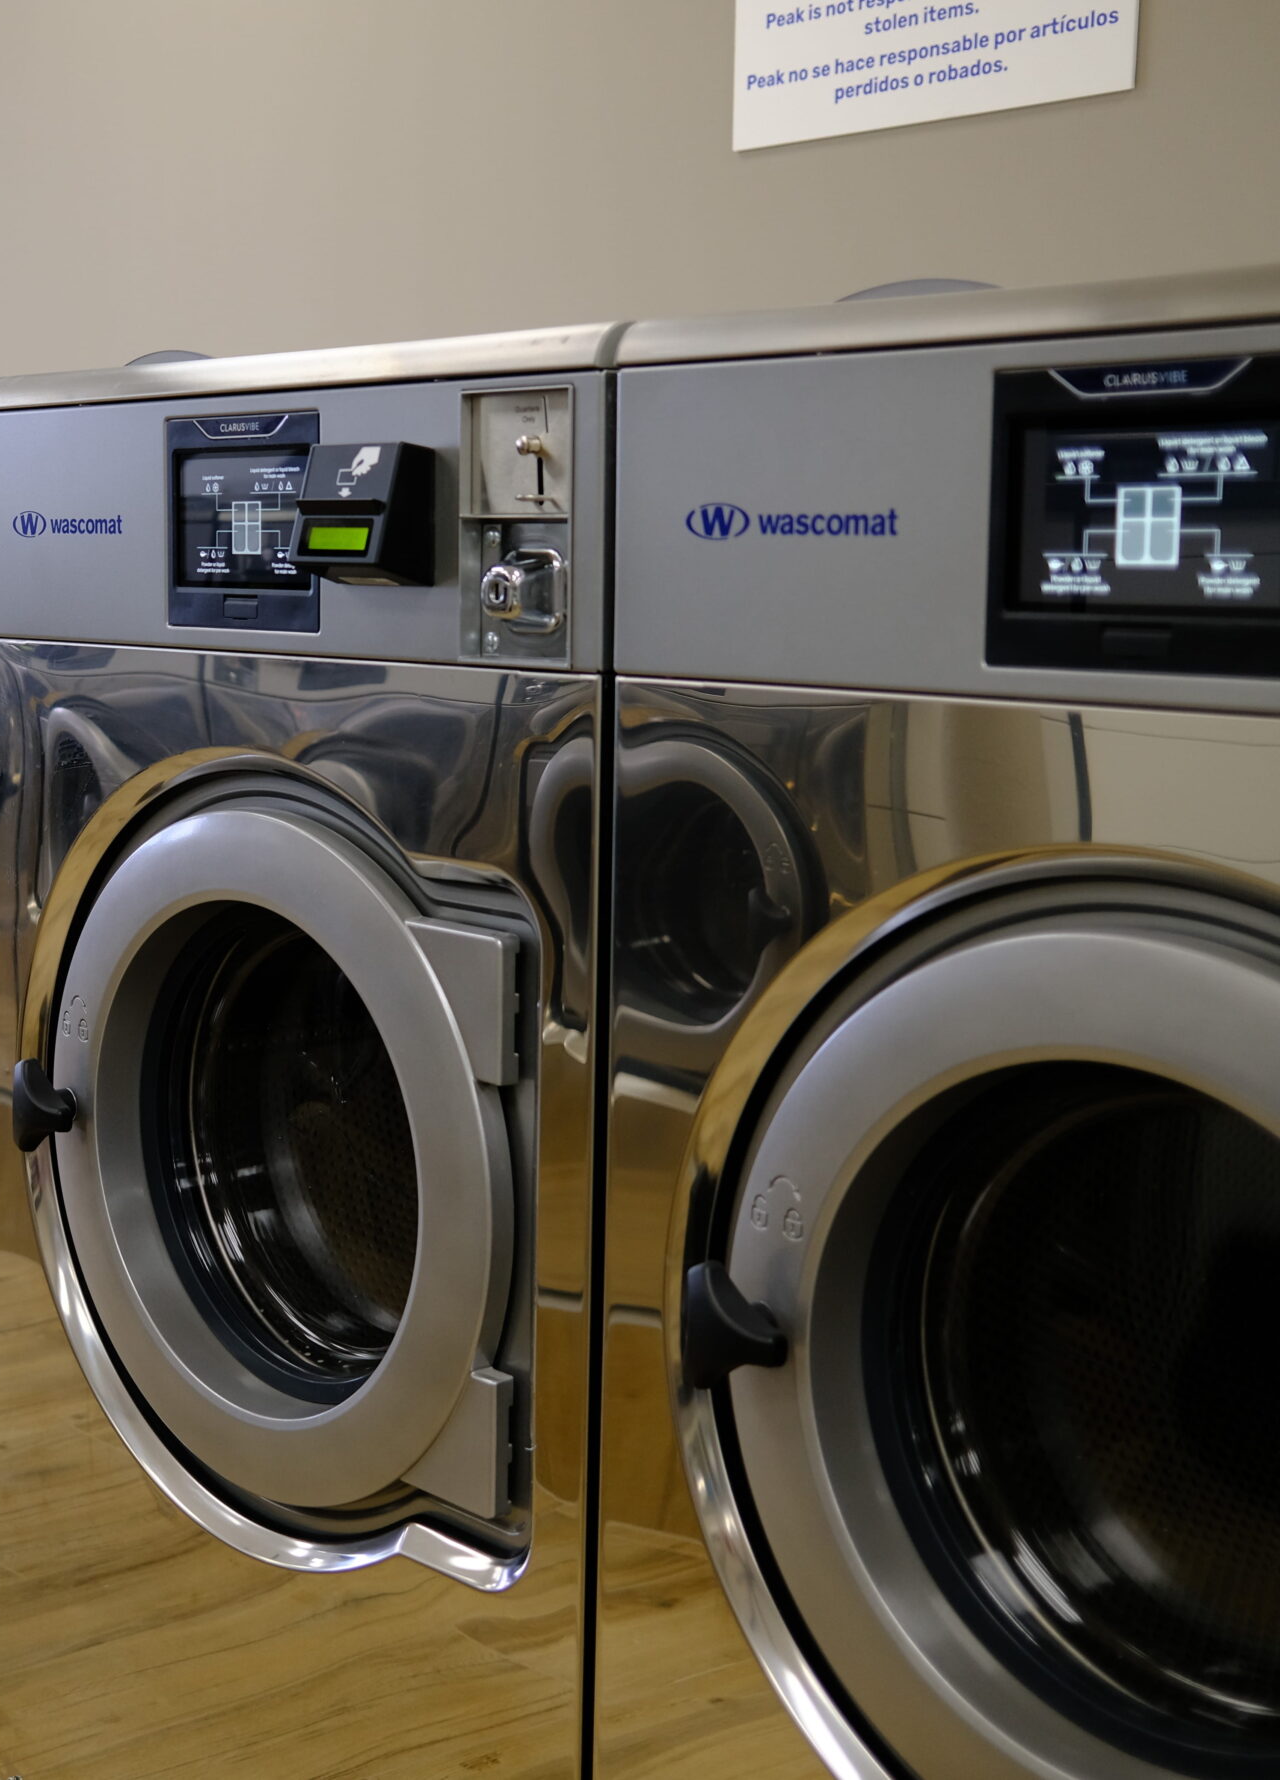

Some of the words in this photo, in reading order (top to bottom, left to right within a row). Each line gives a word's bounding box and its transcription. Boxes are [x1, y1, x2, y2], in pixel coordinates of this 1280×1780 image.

[766, 7, 804, 29] Peak
[808, 4, 821, 21] is
[826, 0, 854, 17] not
[864, 13, 919, 35] stolen
[923, 2, 980, 24] items.
[746, 70, 785, 90] Peak
[788, 68, 808, 83] no
[812, 64, 831, 79] se
[834, 56, 875, 75] hace
[879, 32, 989, 67] responsable
[994, 27, 1027, 50] por
[1029, 9, 1120, 39] artículos
[834, 75, 909, 104] perdidos
[914, 73, 924, 87] o
[928, 59, 1008, 84] robados.
[220, 422, 260, 432] CLARUSVIBE
[50, 514, 122, 535] wascomat
[758, 508, 898, 536] wascomat
